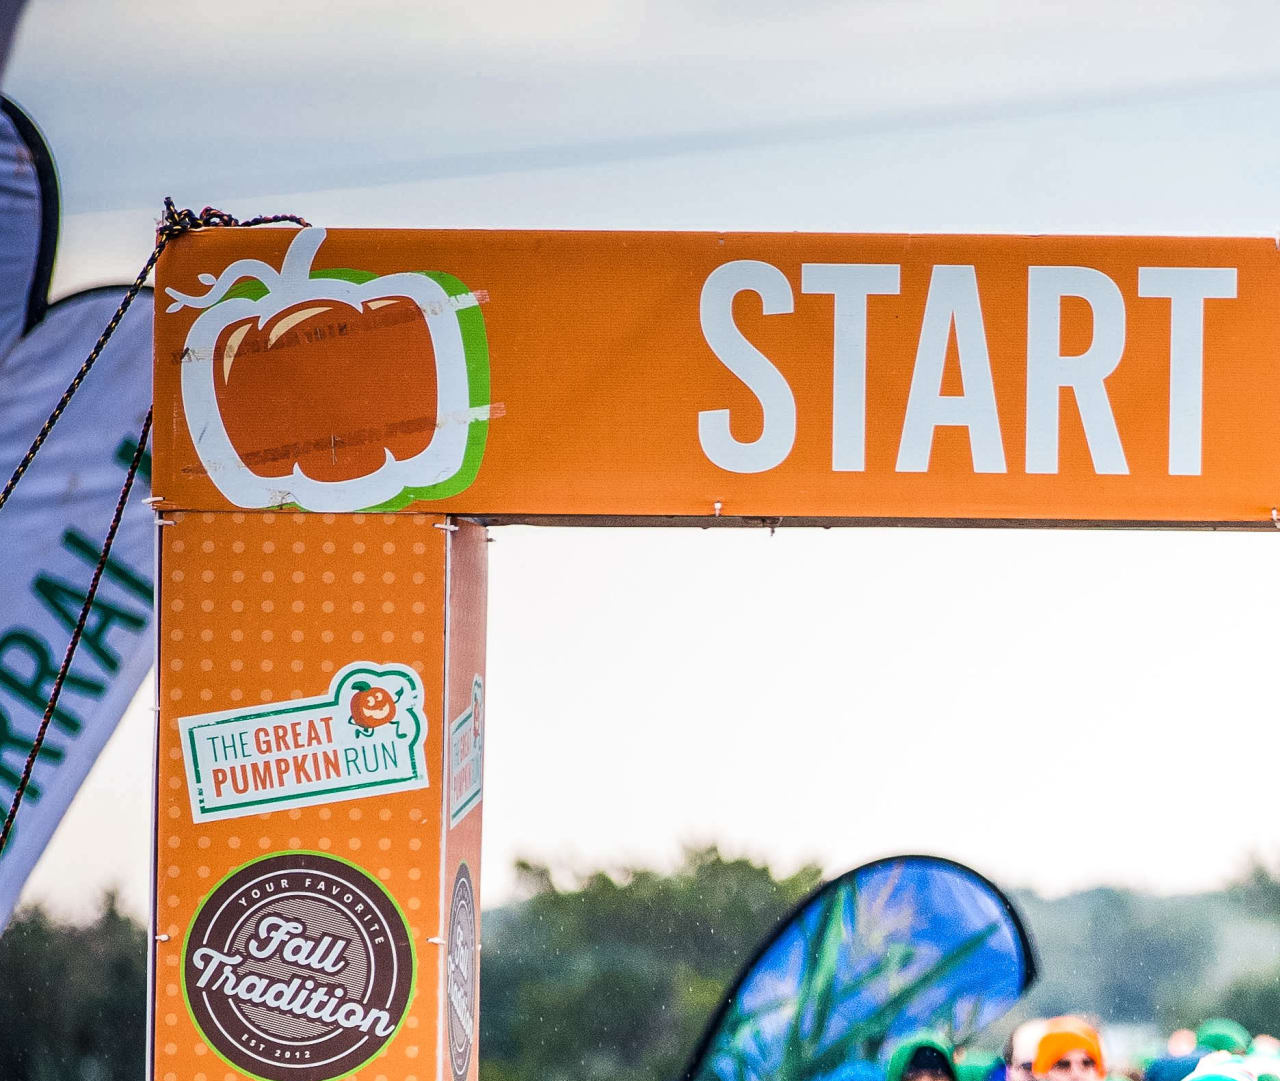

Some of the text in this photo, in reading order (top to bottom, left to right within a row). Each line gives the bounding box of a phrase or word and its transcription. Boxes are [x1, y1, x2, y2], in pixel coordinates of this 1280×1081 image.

[698, 259, 1238, 476] START
[207, 716, 334, 763] THE GREAT
[212, 741, 398, 798] PUMPKIN RUN
[238, 878, 385, 945] YOUR FAVORITE
[249, 916, 347, 973] Fall
[192, 947, 396, 1037] Tradition
[241, 1033, 311, 1059] EST 2012
